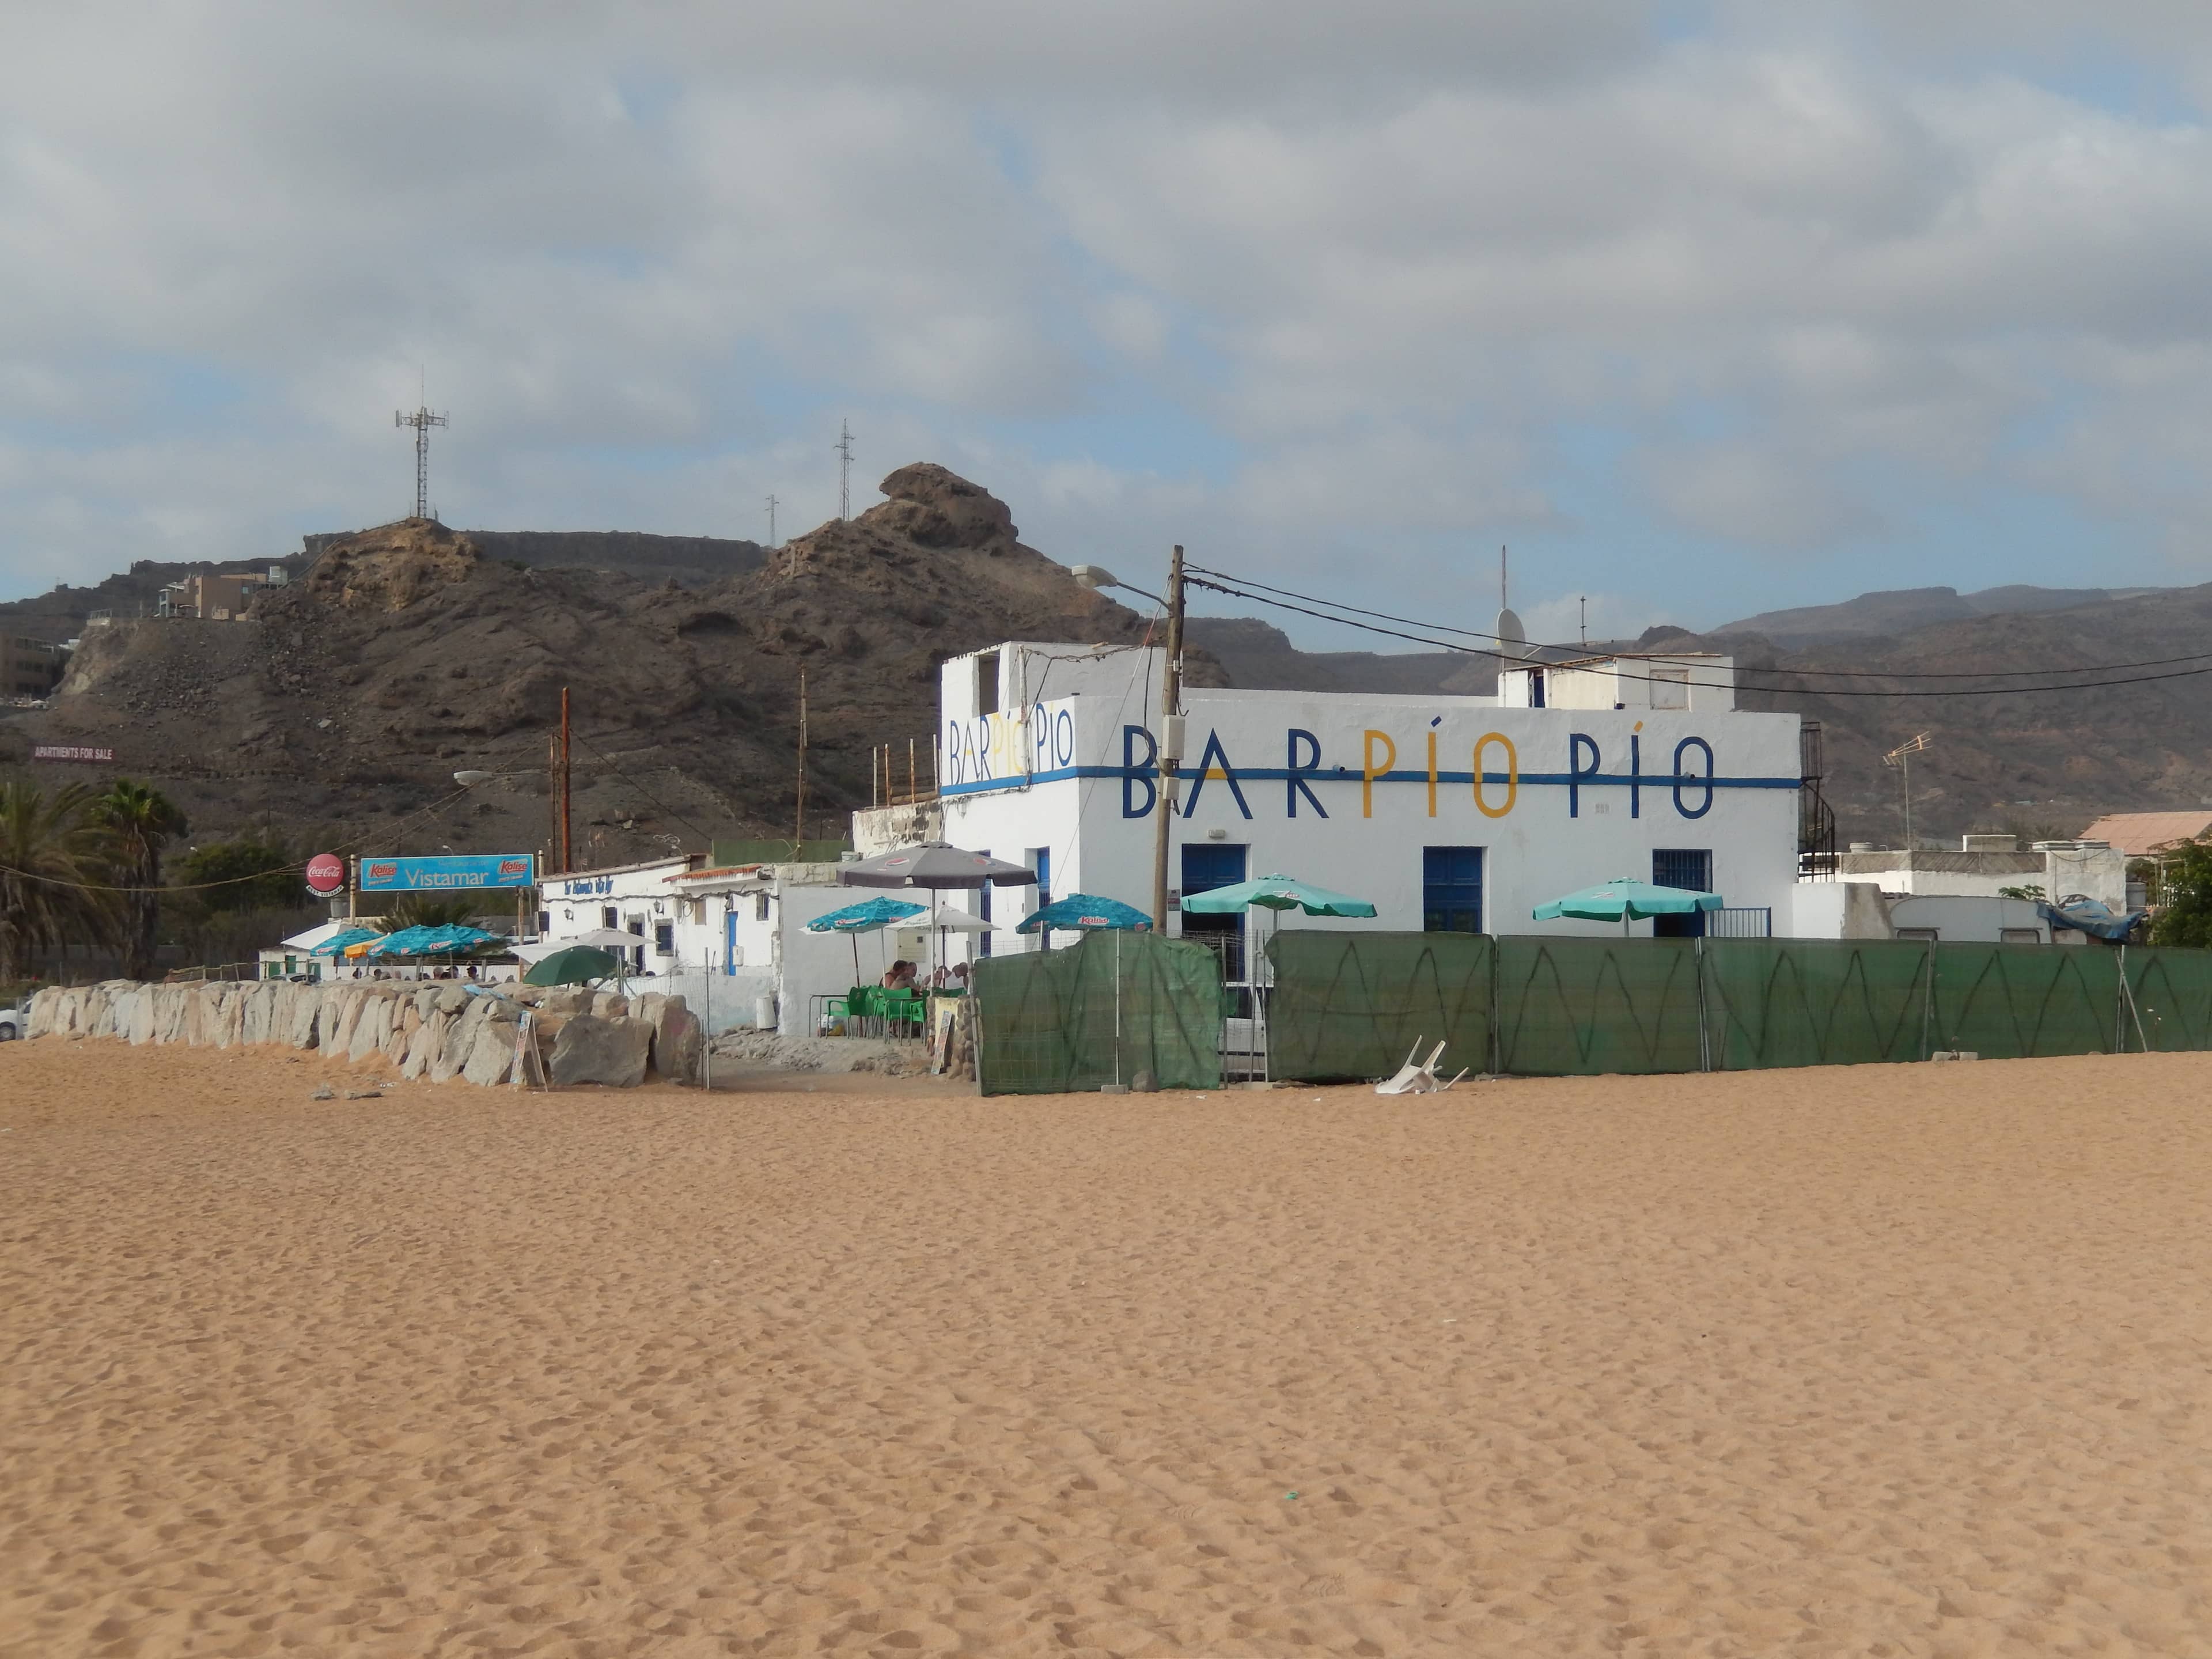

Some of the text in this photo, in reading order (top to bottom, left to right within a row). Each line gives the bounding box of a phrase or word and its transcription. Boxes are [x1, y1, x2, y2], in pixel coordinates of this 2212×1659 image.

[35, 747, 112, 760] APARTMENTS FOR SALE
[950, 715, 991, 786] BAR
[1123, 715, 1714, 819] BAR PÍO PÍO
[370, 864, 396, 877] Kalise
[499, 861, 527, 873] Kalise
[406, 869, 488, 886] Vistamar
